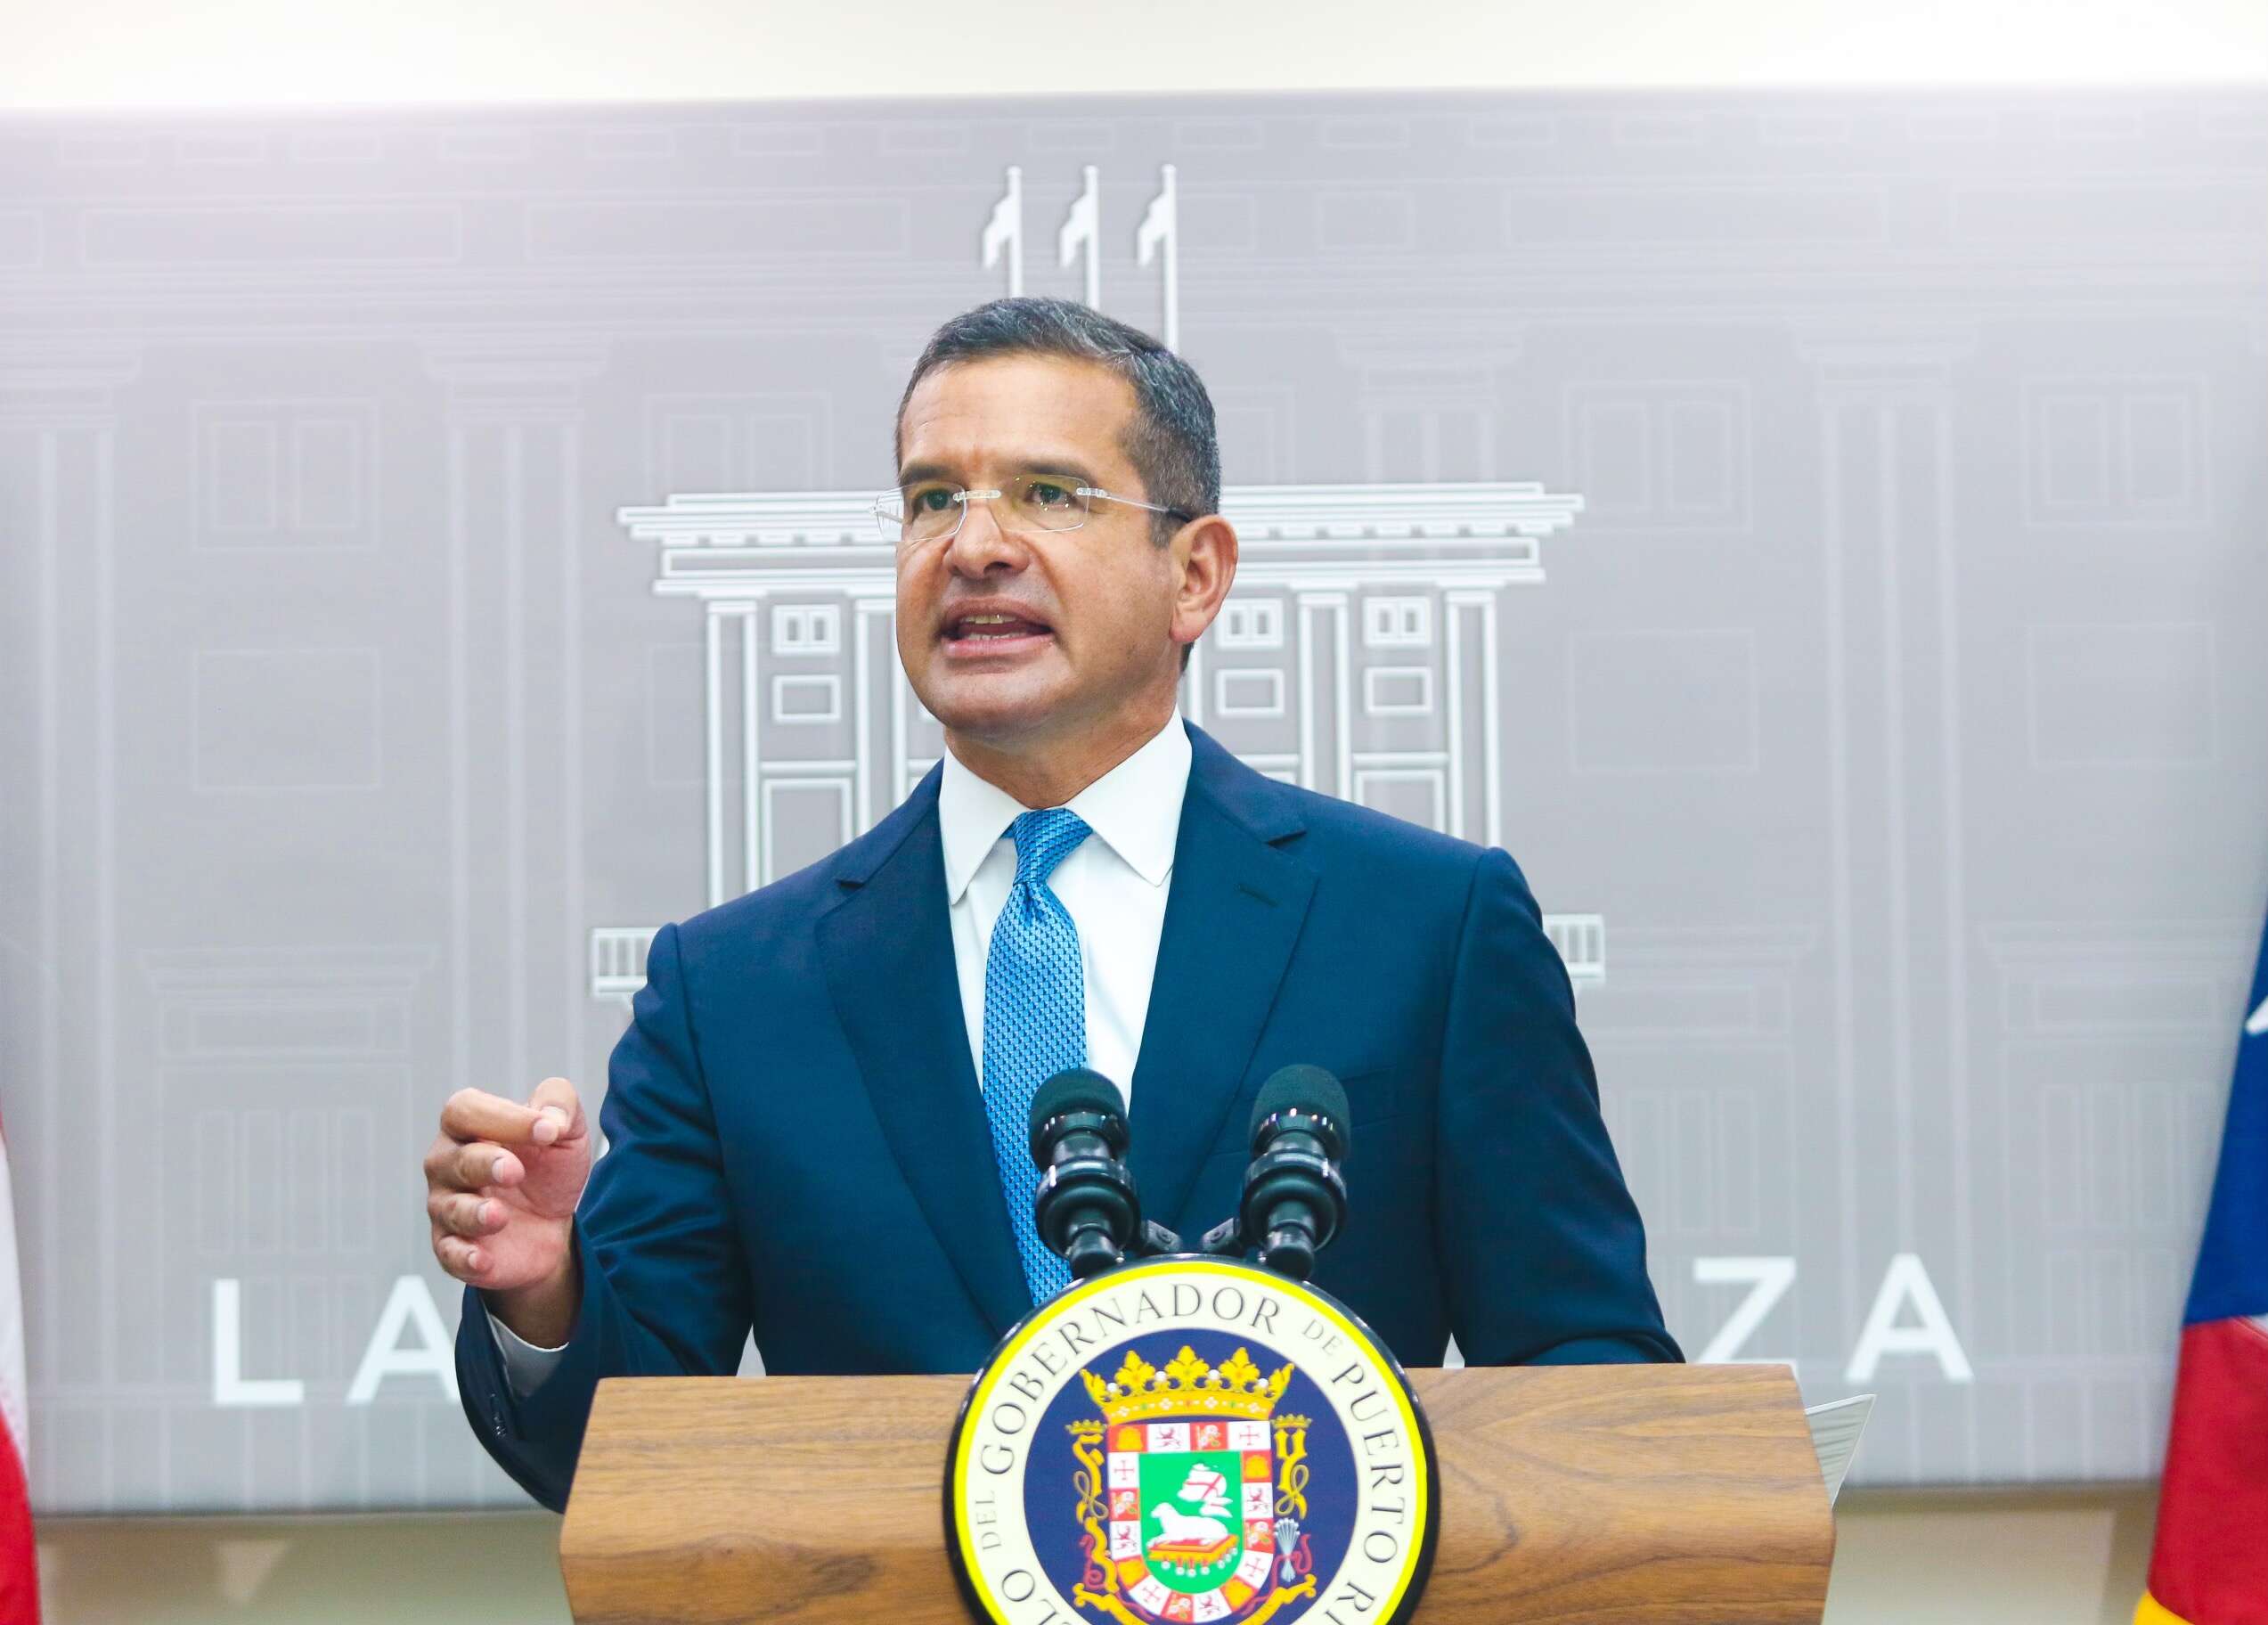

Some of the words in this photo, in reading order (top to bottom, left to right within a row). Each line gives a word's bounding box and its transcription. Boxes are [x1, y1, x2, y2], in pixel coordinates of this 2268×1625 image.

[215, 1275, 460, 1404] LA
[981, 1283, 1280, 1474] GOBERNADOR
[1301, 1319, 1342, 1356] DE
[975, 1490, 1001, 1551] DEL
[1331, 1362, 1405, 1563] PUERTO
